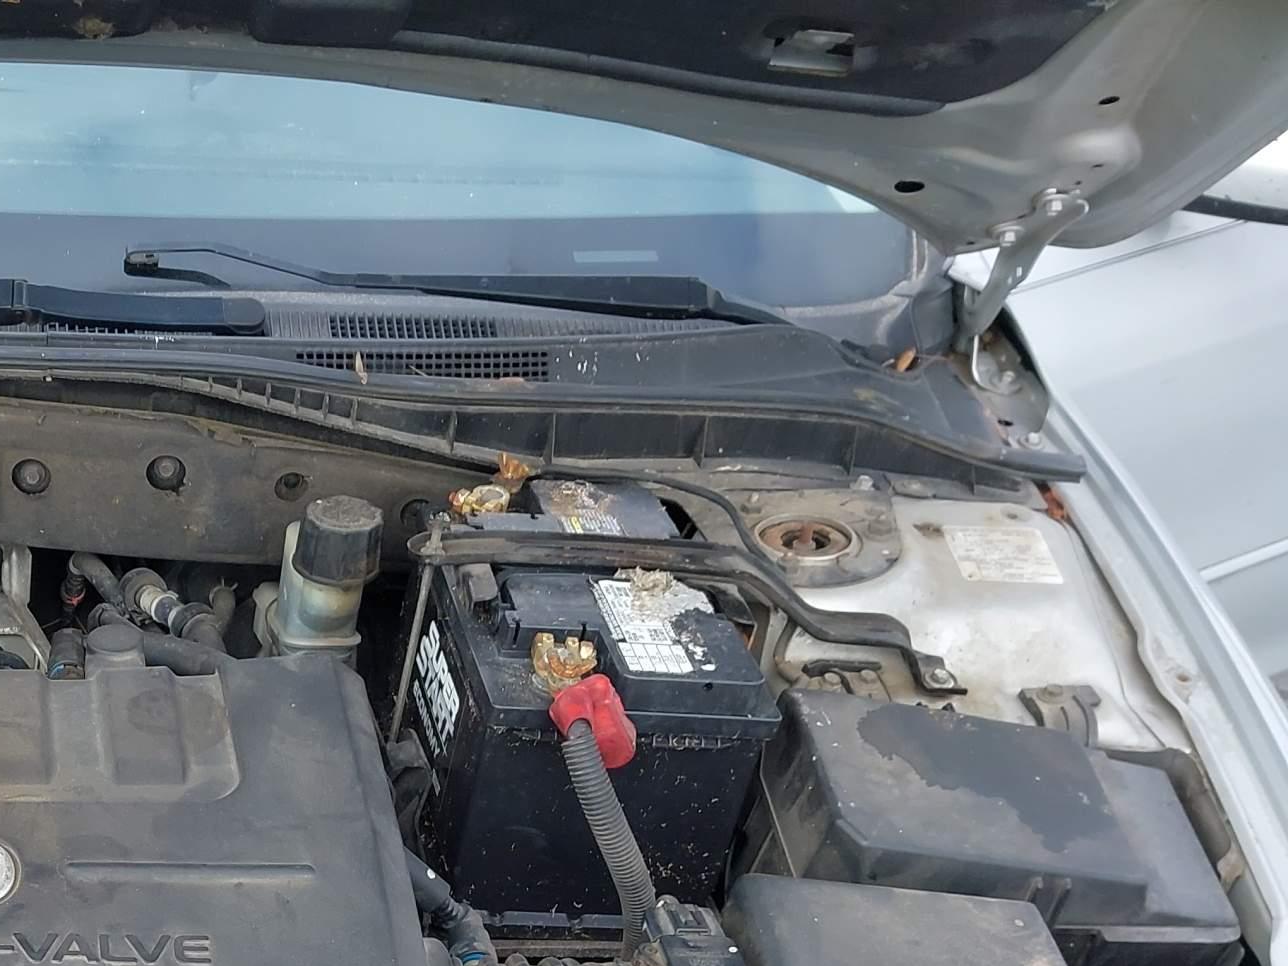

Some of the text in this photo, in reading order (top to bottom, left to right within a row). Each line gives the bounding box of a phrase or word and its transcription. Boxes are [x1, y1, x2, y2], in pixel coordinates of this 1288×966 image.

[413, 679, 441, 759] ECONOMY
[416, 635, 454, 743] START
[429, 620, 460, 724] SUPER
